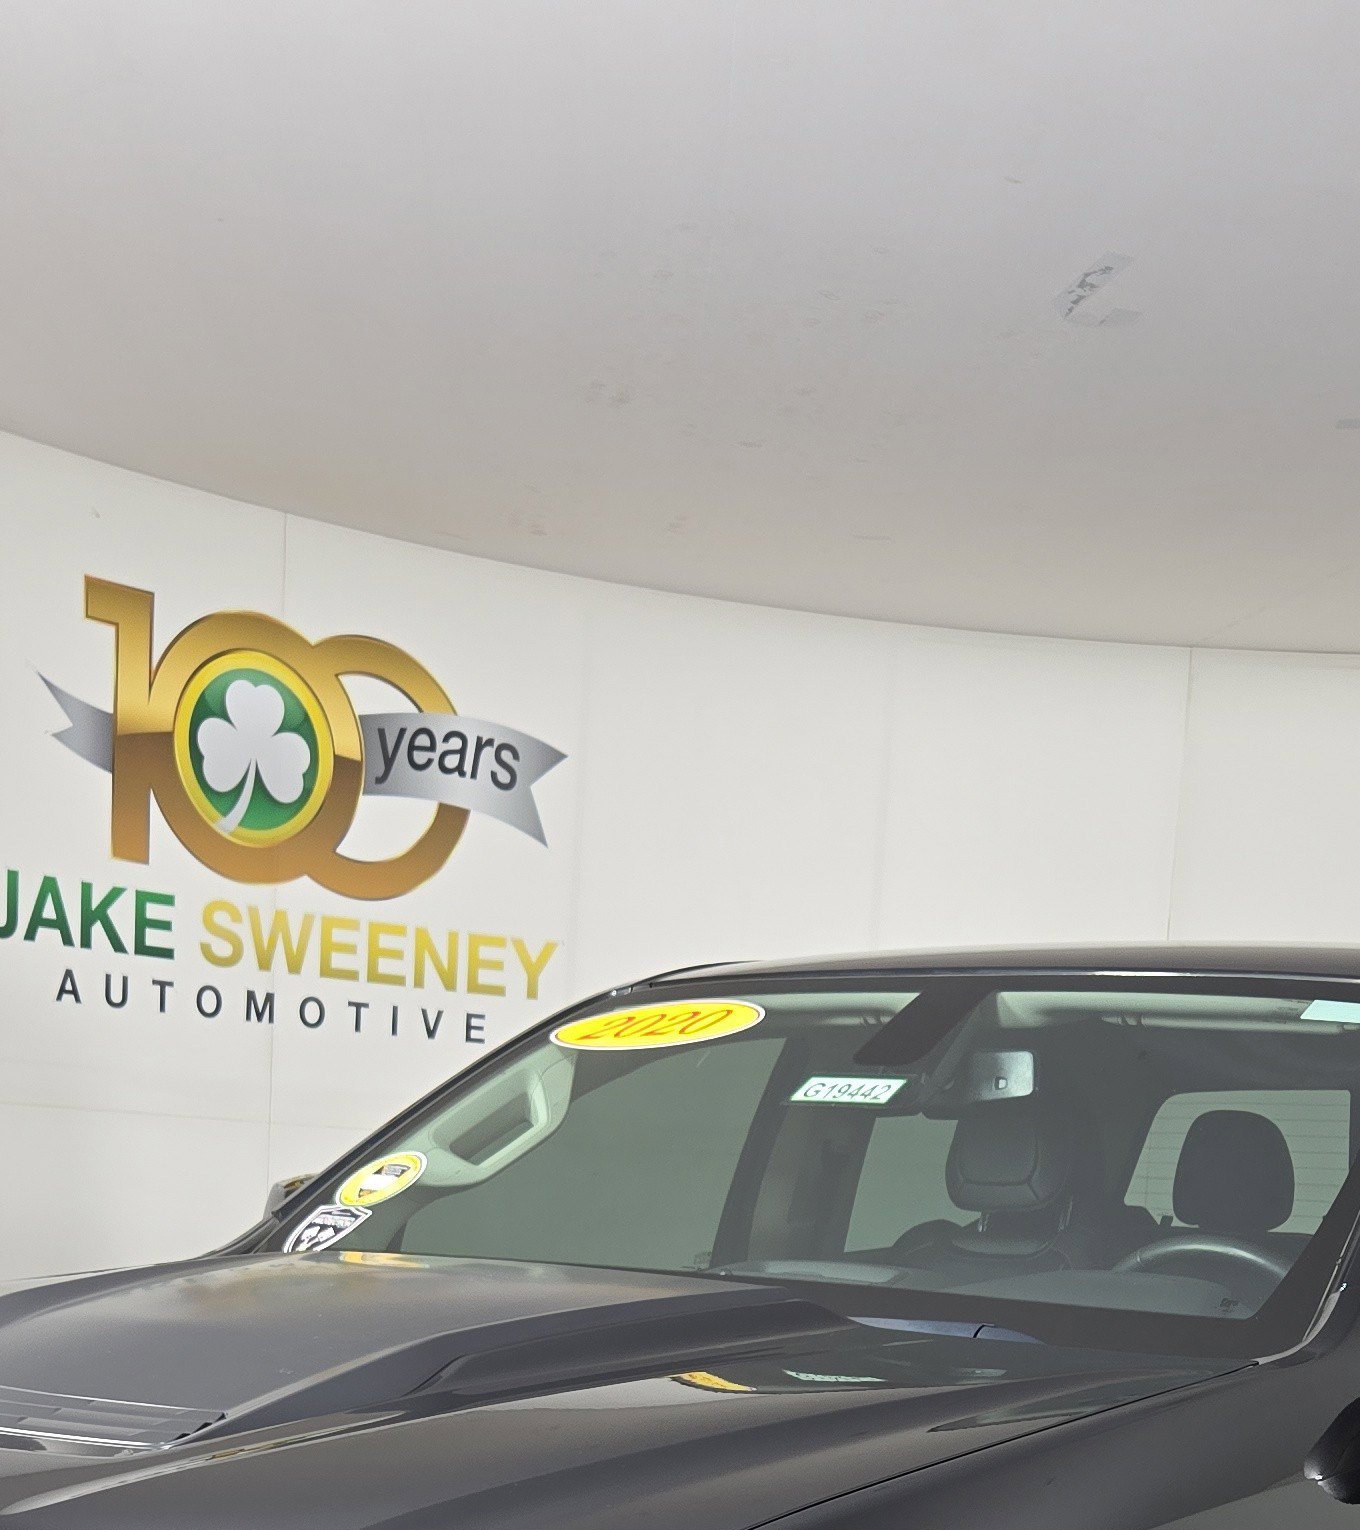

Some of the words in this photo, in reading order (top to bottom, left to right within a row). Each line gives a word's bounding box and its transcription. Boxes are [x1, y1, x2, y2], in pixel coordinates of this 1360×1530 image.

[84, 573, 471, 902] 100
[374, 723, 522, 791] years
[198, 900, 559, 1001] SWEENEY
[55, 967, 487, 1045] AUTOMOTIVE
[574, 1008, 734, 1041] 2020
[803, 1082, 892, 1100] G19442
